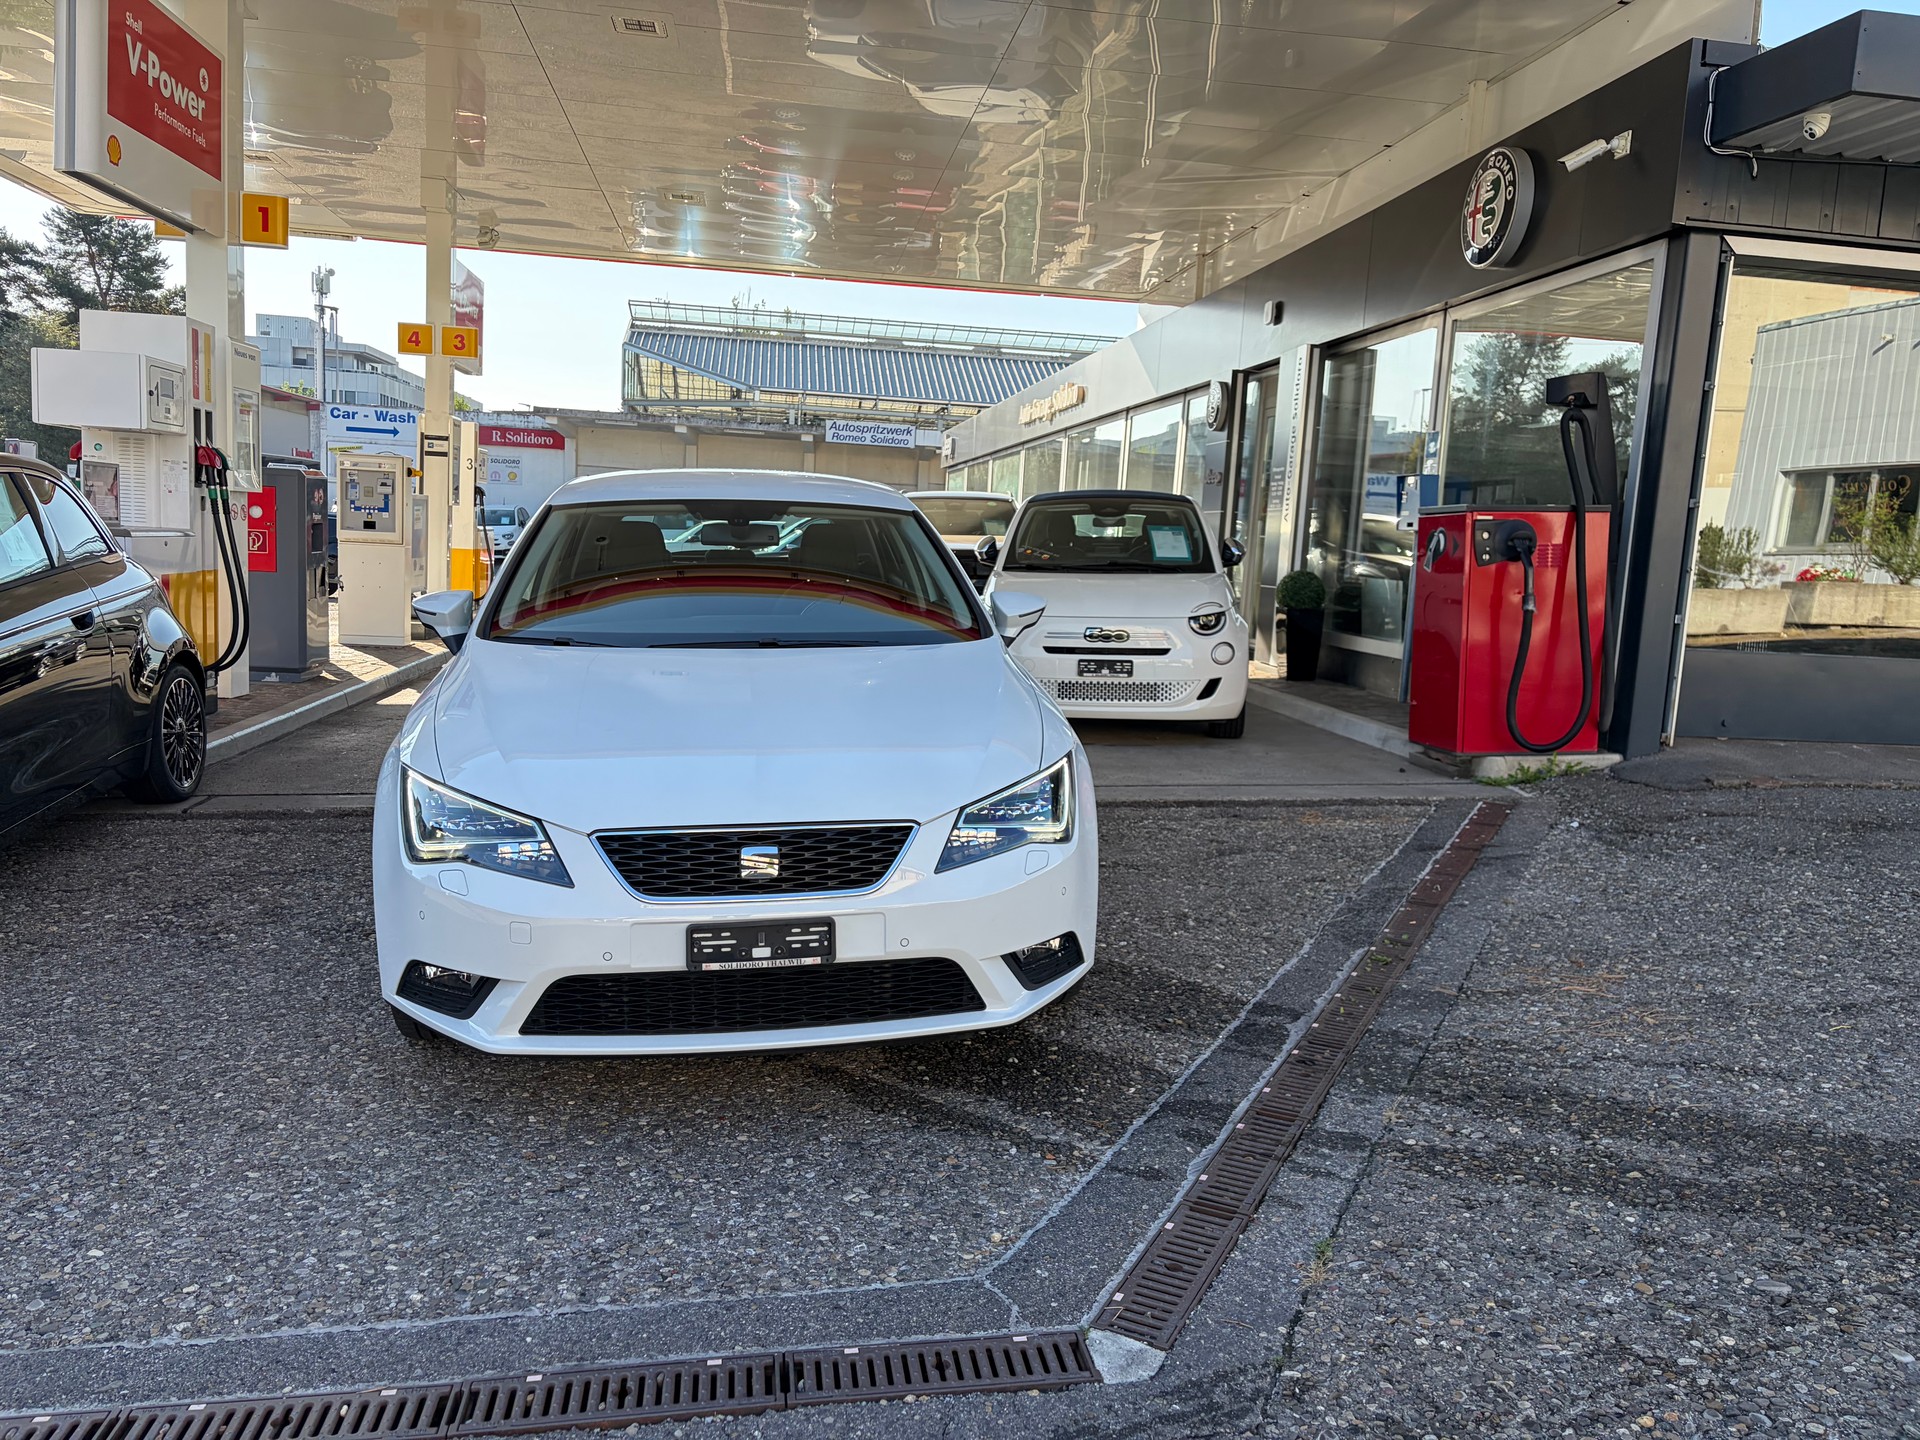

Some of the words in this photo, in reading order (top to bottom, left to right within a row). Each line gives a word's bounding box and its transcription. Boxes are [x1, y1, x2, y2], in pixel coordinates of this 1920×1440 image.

[125, 11, 143, 35] Shell
[125, 32, 206, 122] V-Power
[154, 102, 191, 138] Performance
[192, 127, 206, 148] Fuels
[1487, 155, 1514, 201] ROMEO
[257, 206, 269, 233] 1
[407, 330, 421, 347] 4
[453, 333, 466, 351] 3
[330, 406, 359, 420] Car
[374, 409, 416, 424] Wash
[829, 420, 913, 437] Autospritzwerk
[505, 430, 553, 446] Solidoro
[831, 431, 867, 443] Romeo
[869, 434, 910, 446] Solidoro
[466, 457, 474, 471] 3
[490, 457, 521, 465] SOLIDORO
[1083, 627, 1130, 643] 500
[719, 961, 764, 970] SOLIDORO
